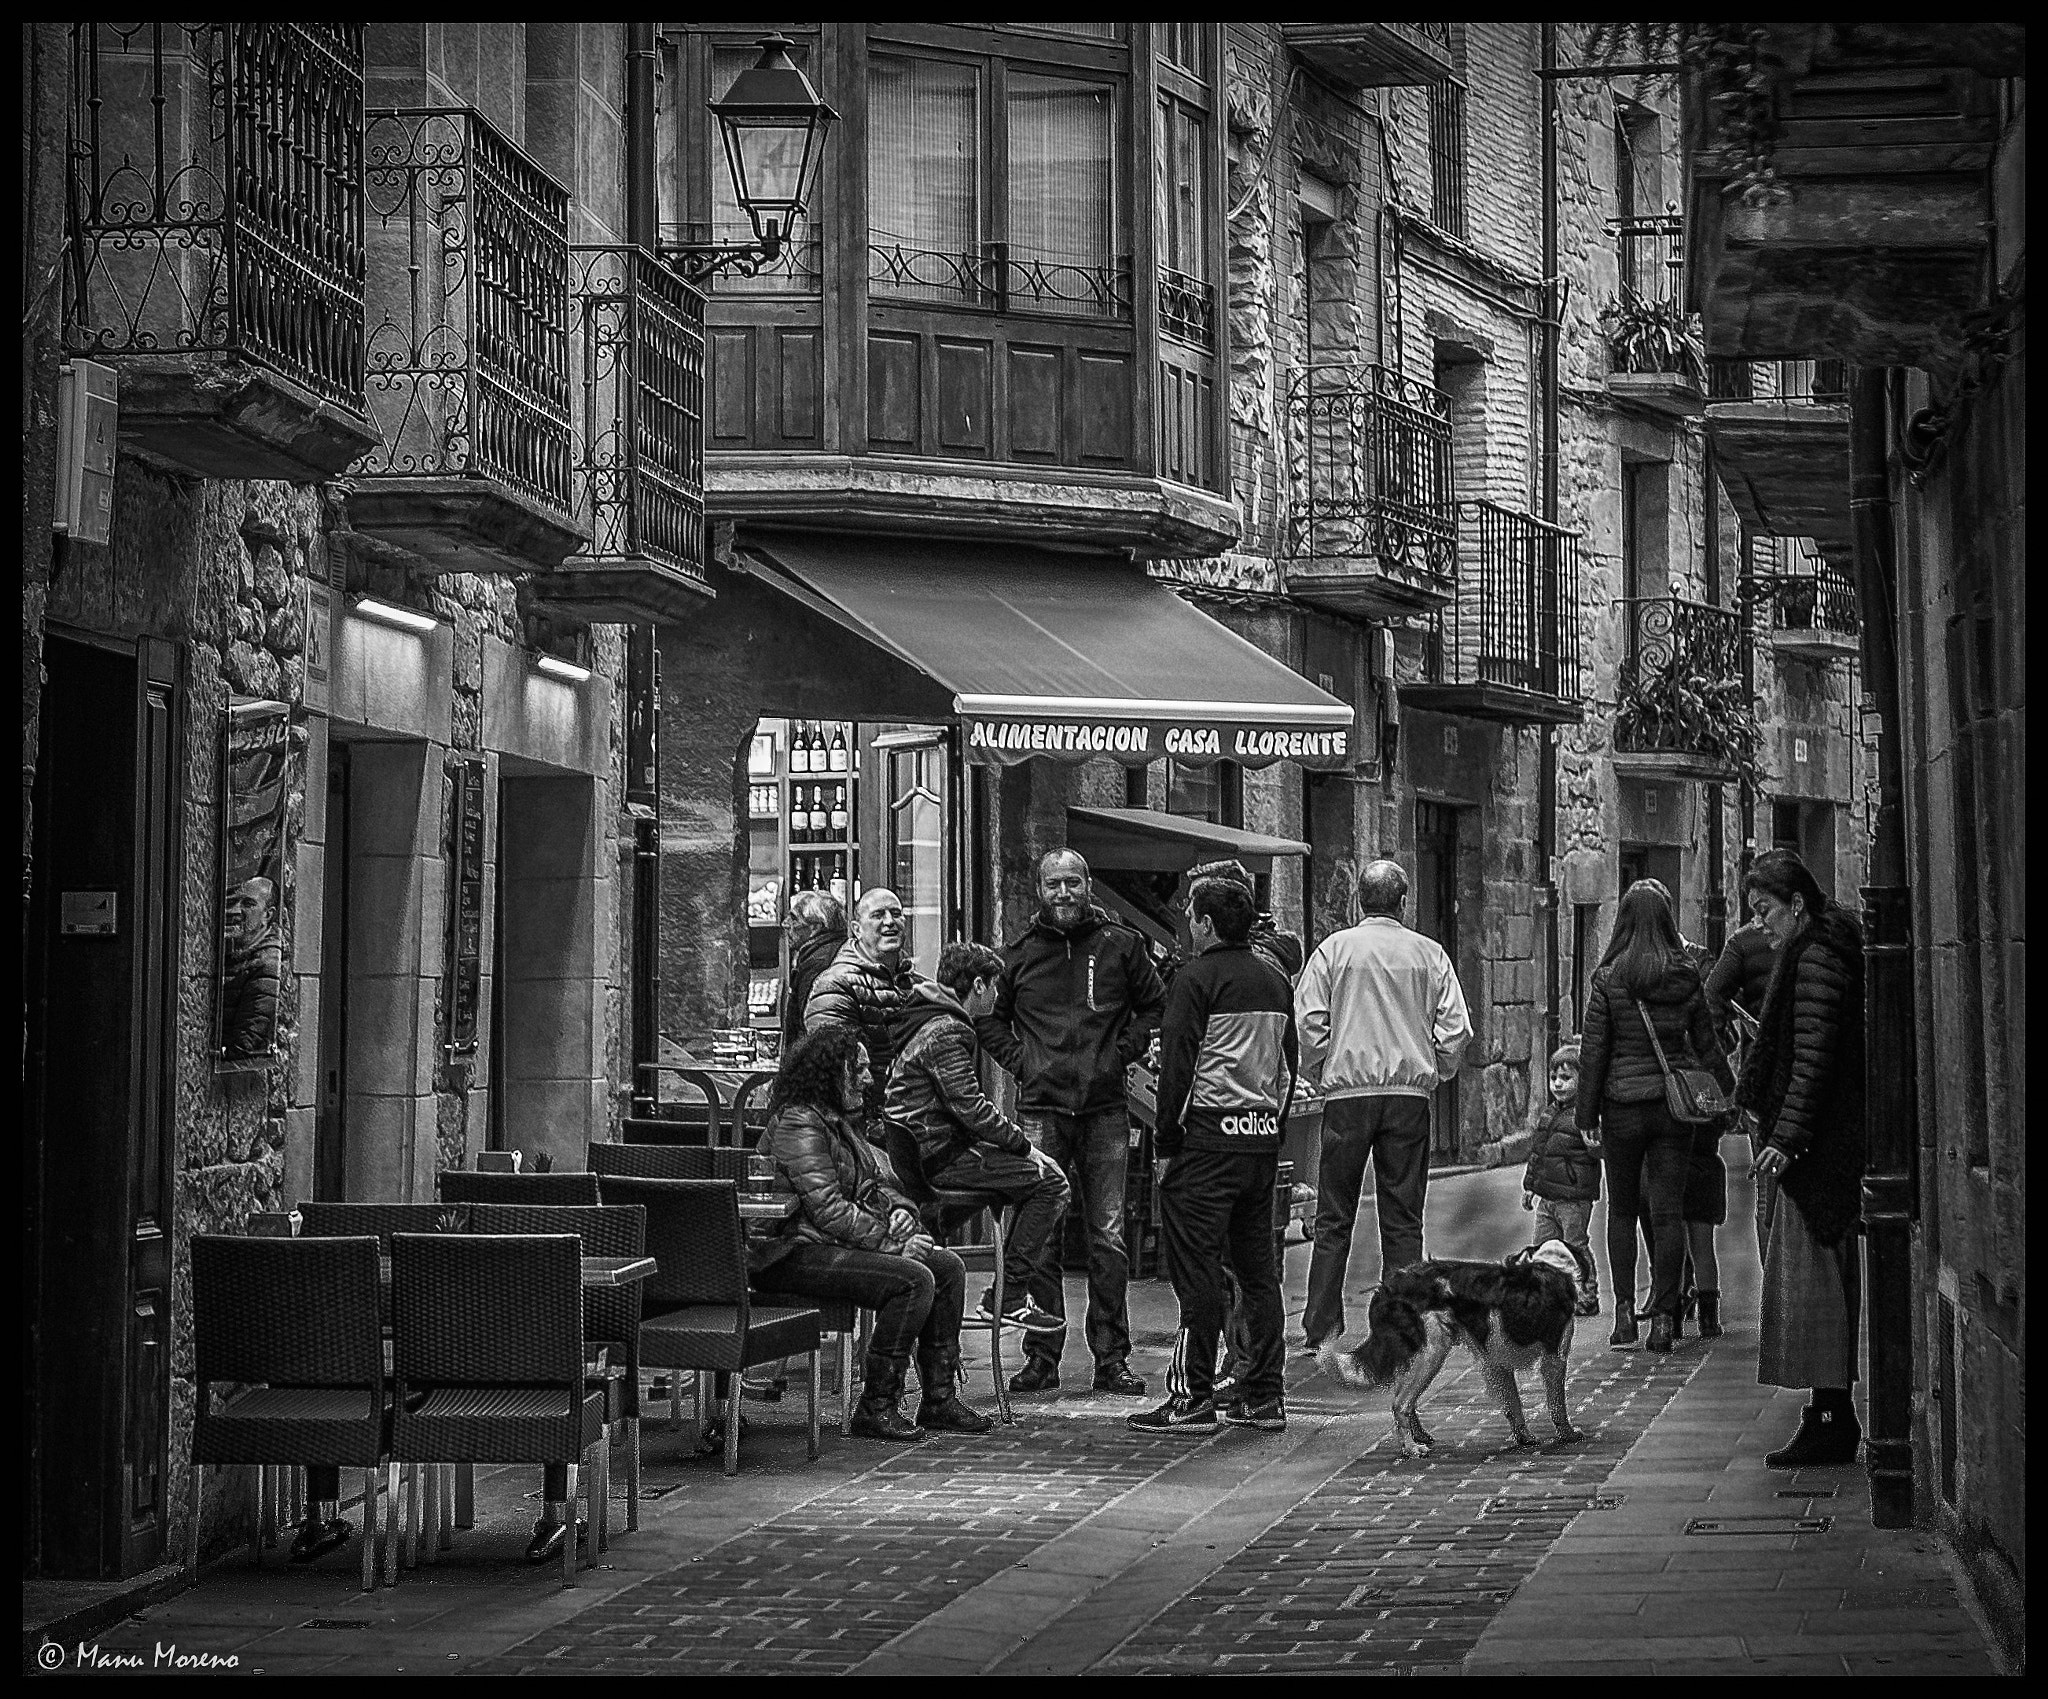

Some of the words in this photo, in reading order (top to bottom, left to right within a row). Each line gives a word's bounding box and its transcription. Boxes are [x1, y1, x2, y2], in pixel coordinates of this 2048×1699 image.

[970, 722, 1148, 752] ALIMENTACION
[1164, 728, 1220, 754] CASA
[1234, 730, 1347, 757] LLORENTE
[1220, 1111, 1279, 1136] adida
